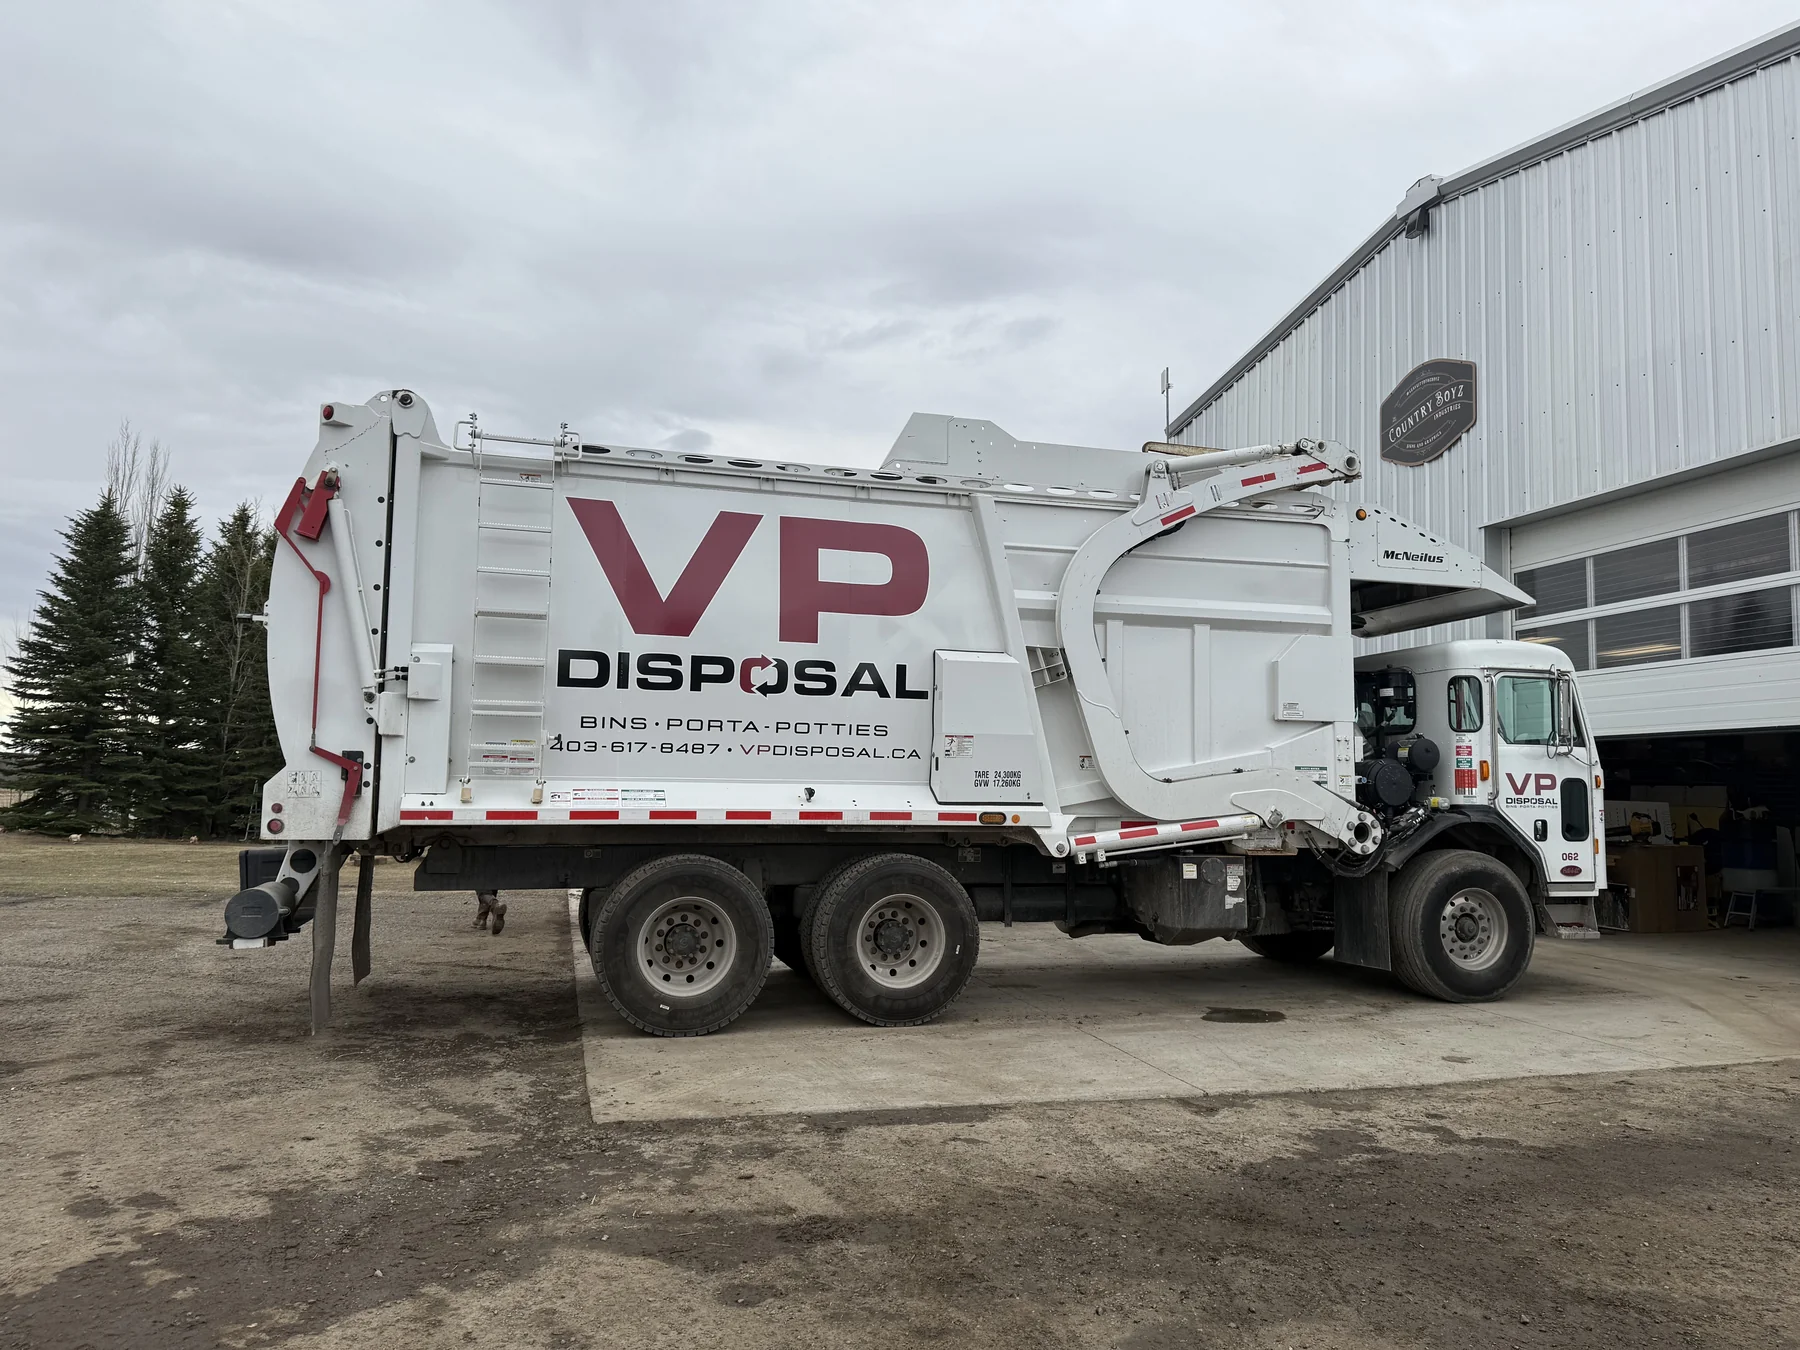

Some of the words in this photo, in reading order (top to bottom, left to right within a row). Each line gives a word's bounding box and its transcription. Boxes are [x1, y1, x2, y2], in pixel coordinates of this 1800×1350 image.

[1388, 399, 1433, 443] COUNTRY
[1435, 384, 1464, 407] BOYZ
[1433, 402, 1461, 420] INDUSTRIES
[1383, 550, 1444, 563] McNeilus
[565, 497, 930, 644] VP
[556, 649, 929, 700] DISPOSAL
[580, 716, 647, 730] BINS
[550, 740, 720, 755] 403-617-8487
[740, 744, 922, 760] VPDISPOSAL.CA
[974, 770, 990, 779] TARE
[994, 770, 1021, 779] 24,300KG
[974, 779, 990, 788] GVW
[993, 779, 1021, 788] 17,260KG
[1505, 773, 1557, 795] VP
[1506, 797, 1558, 805] DISPOSAL
[1562, 853, 1579, 861] 062
